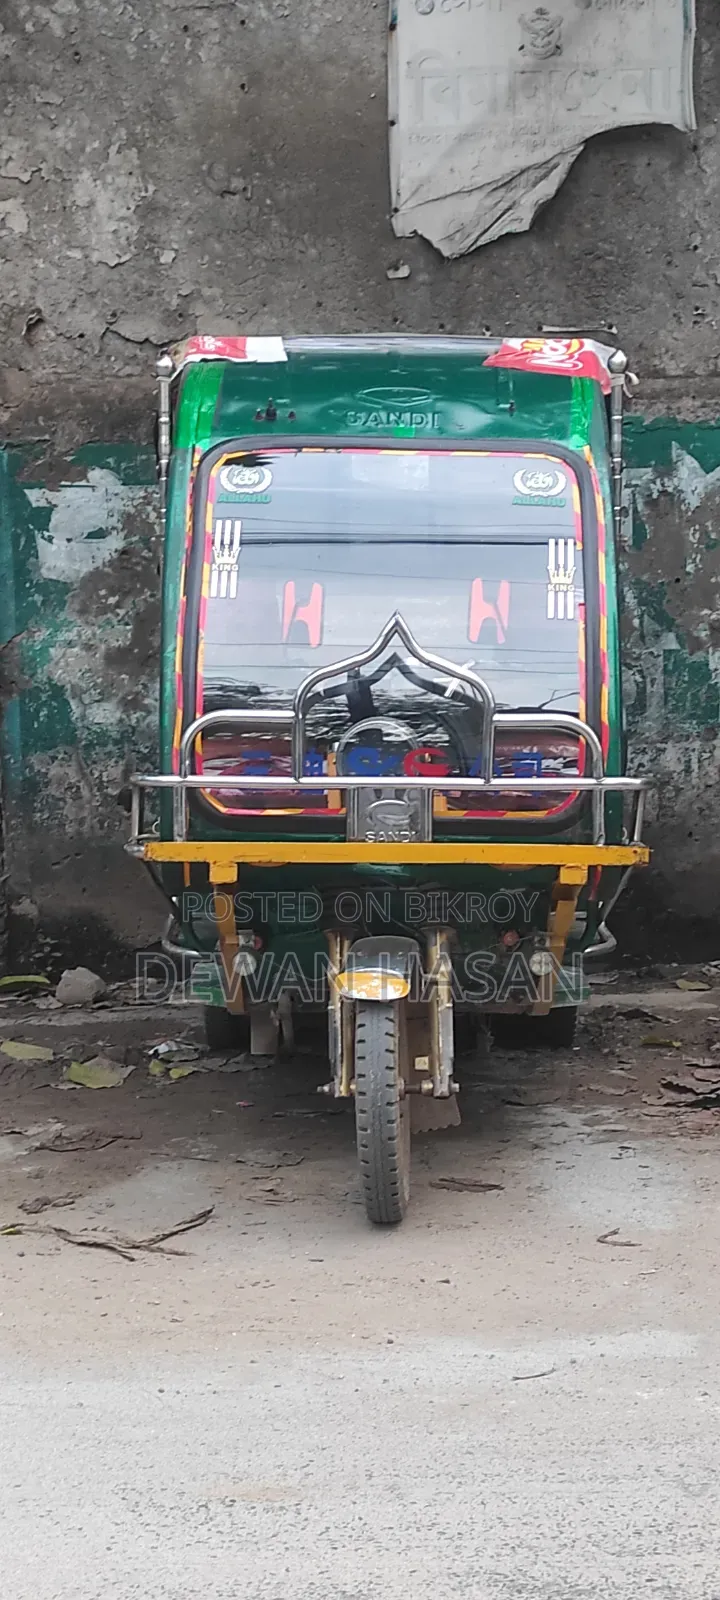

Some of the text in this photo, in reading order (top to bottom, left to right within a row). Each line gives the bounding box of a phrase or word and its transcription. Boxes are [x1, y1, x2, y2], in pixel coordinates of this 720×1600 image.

[345, 411, 440, 428] SANDI
[212, 563, 239, 572] KING
[547, 583, 575, 592] KING
